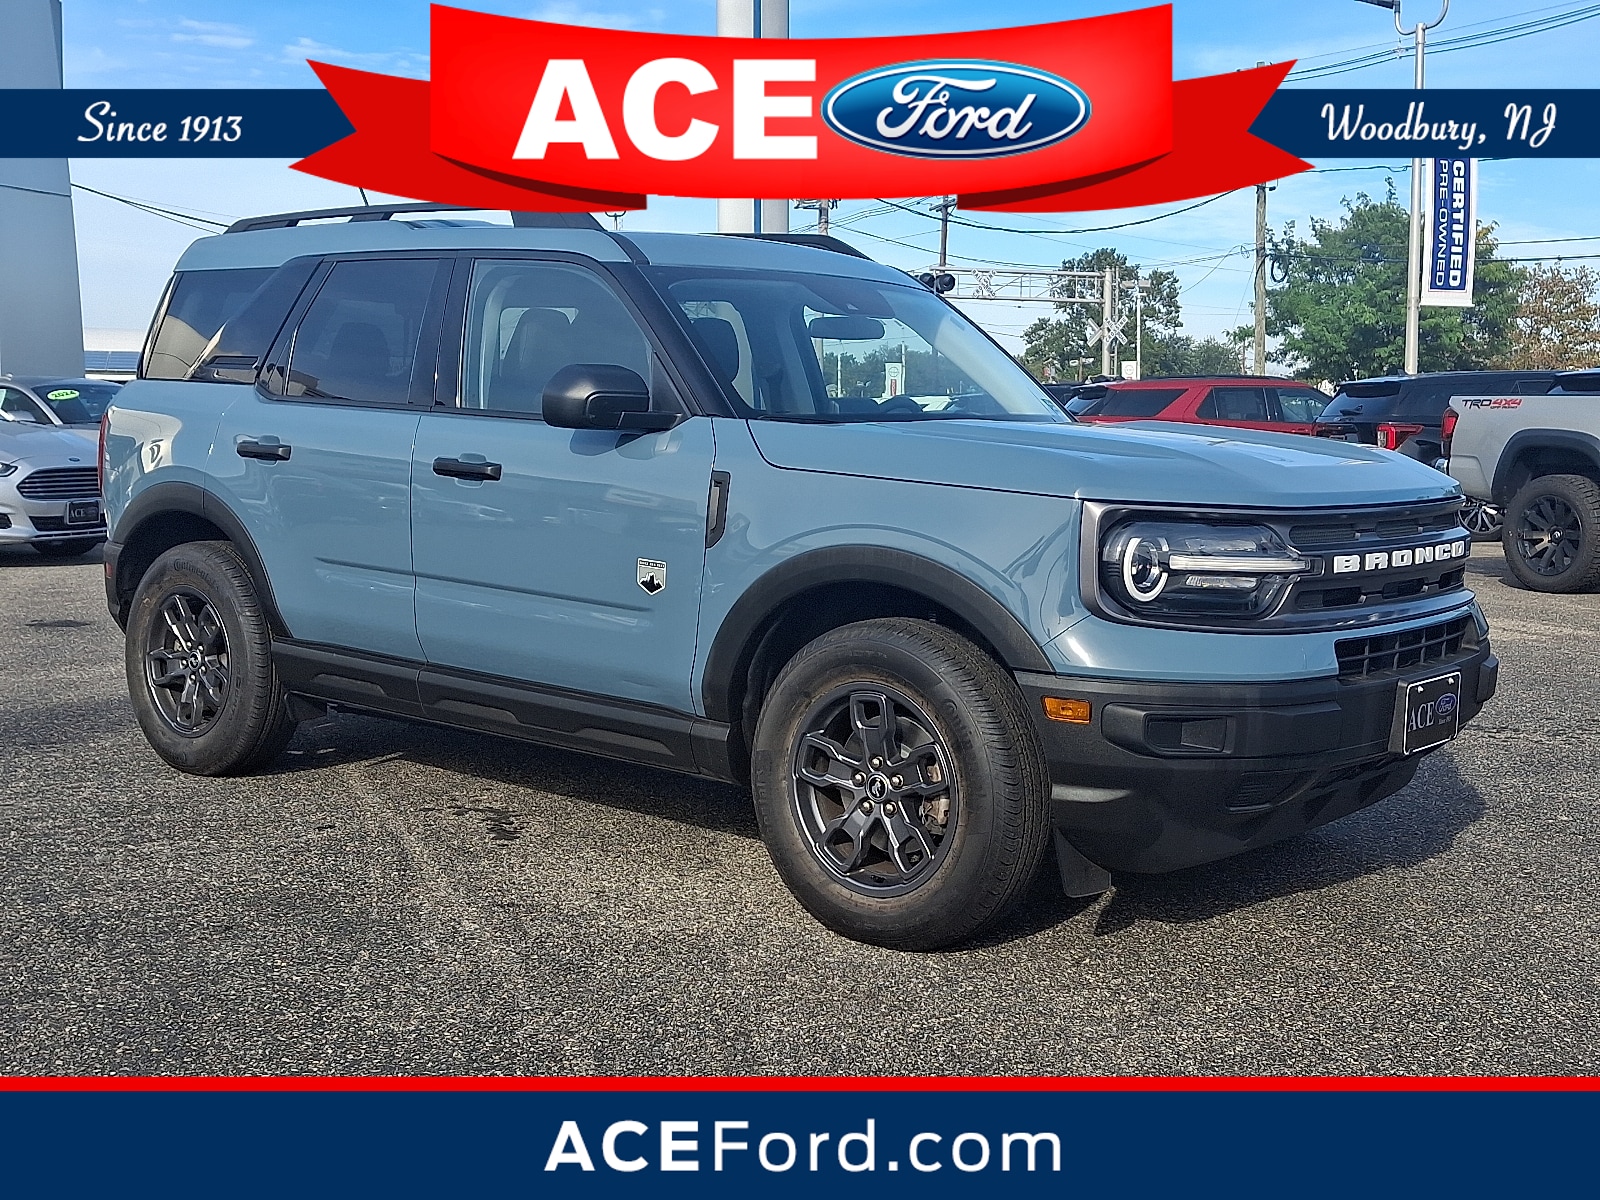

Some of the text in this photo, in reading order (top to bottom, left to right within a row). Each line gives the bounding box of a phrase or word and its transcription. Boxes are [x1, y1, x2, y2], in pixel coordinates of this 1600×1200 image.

[1436, 159, 1449, 286] PRE-OWNED
[1449, 160, 1465, 287] CERTIFIED
[1333, 540, 1465, 574] BRONCO
[1407, 701, 1435, 732] ACE
